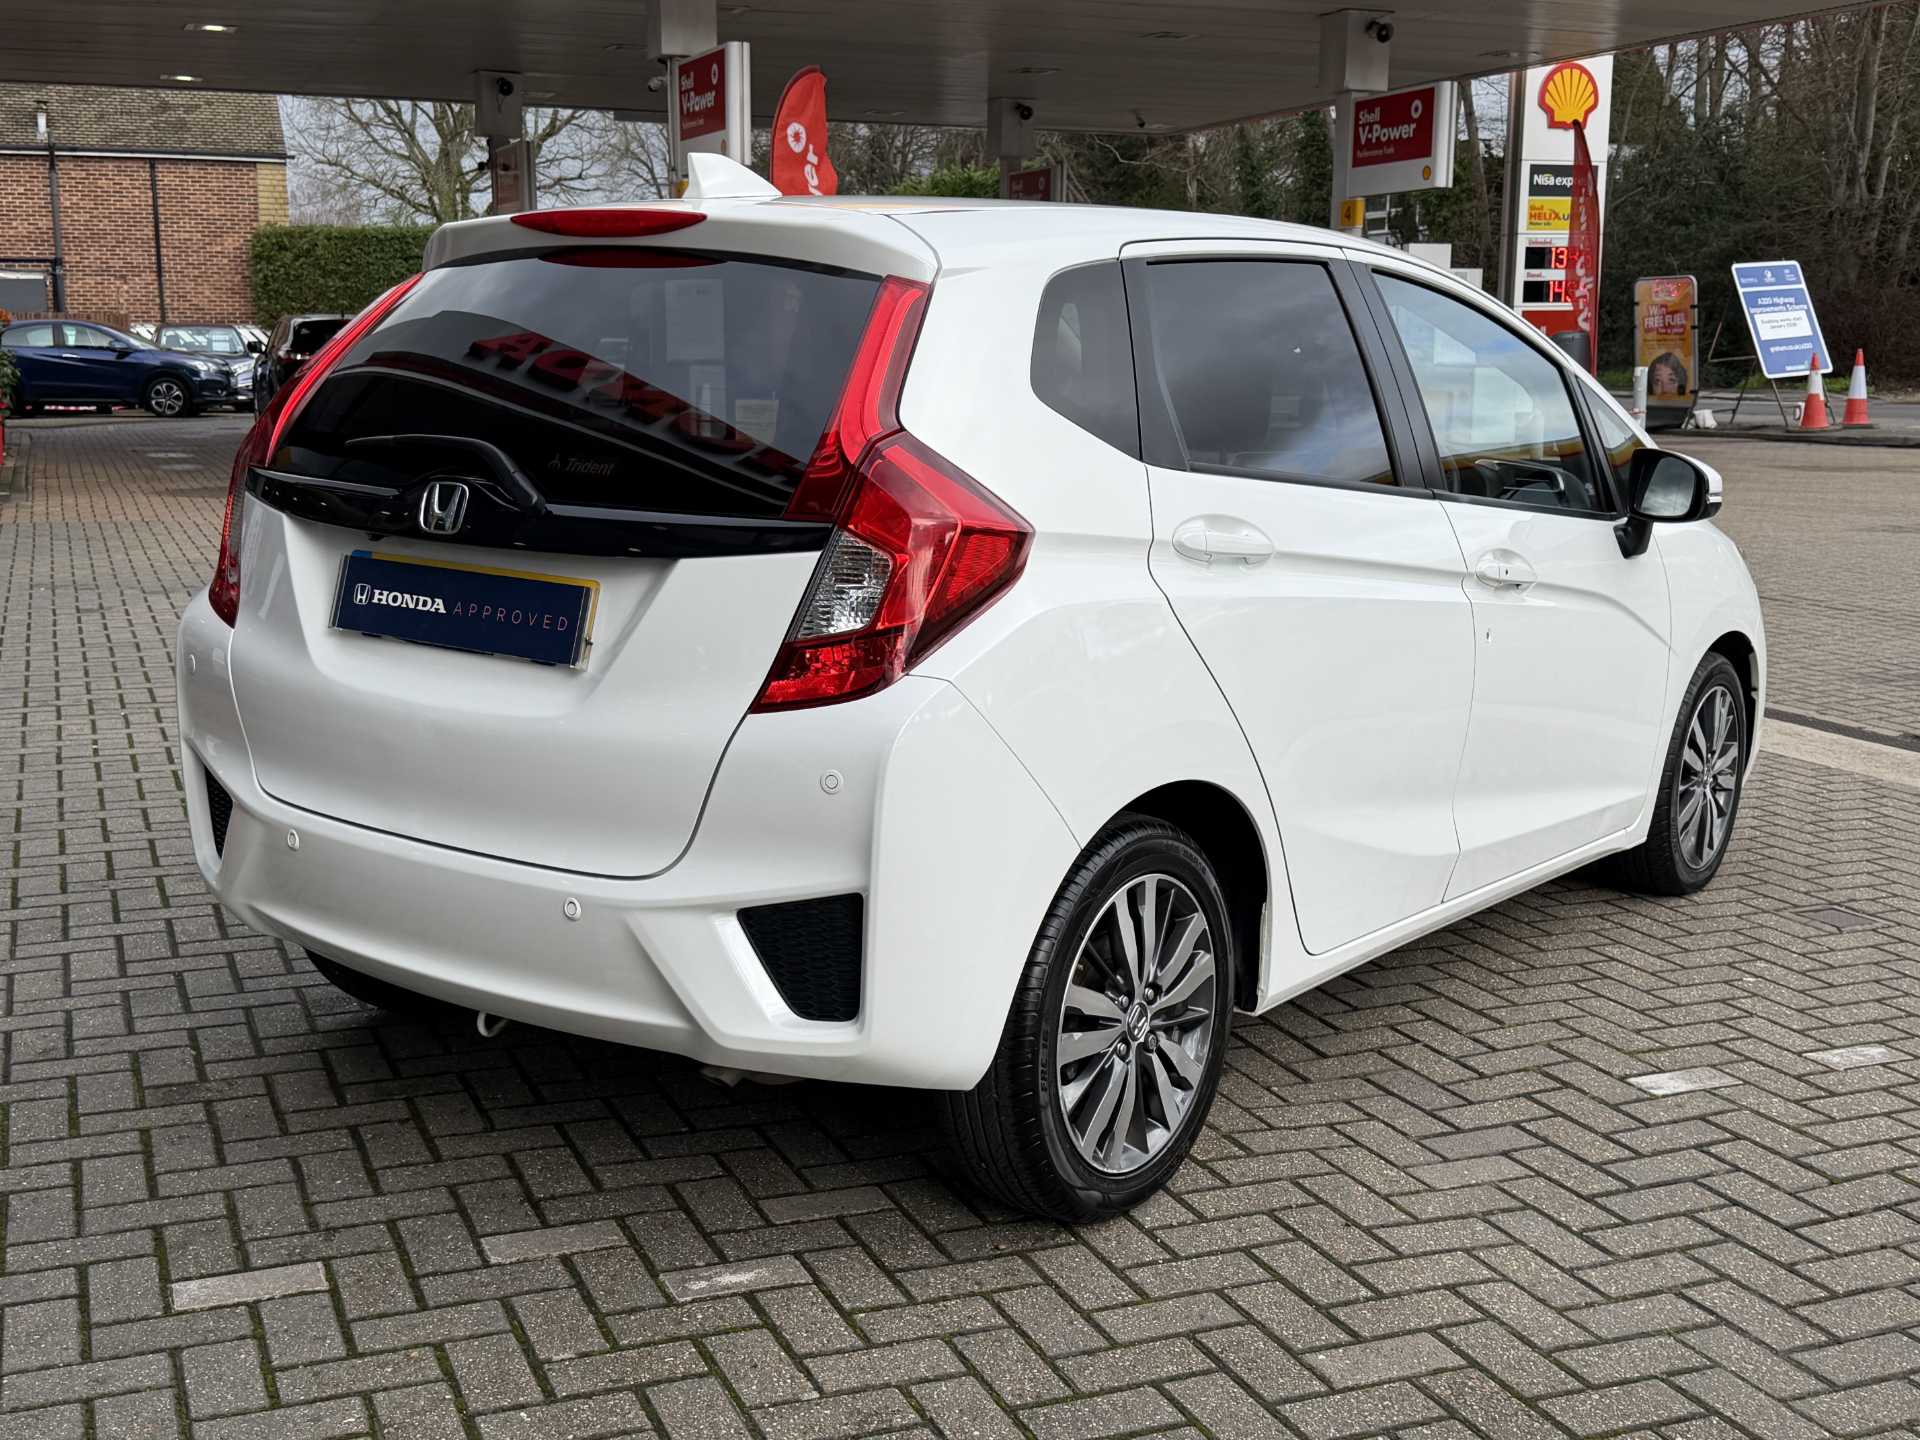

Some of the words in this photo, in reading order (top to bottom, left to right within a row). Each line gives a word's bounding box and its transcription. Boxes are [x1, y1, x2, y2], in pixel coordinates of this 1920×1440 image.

[681, 90, 716, 115] V-Power
[1358, 107, 1381, 125] Shell
[1358, 122, 1417, 145] V-Power
[1533, 173, 1555, 186] Nisa
[1644, 315, 1665, 329] FREE
[1665, 312, 1686, 327] FUEL
[565, 457, 615, 478] Trident
[373, 588, 447, 614] HONDA
[453, 601, 568, 631] APPROVED
